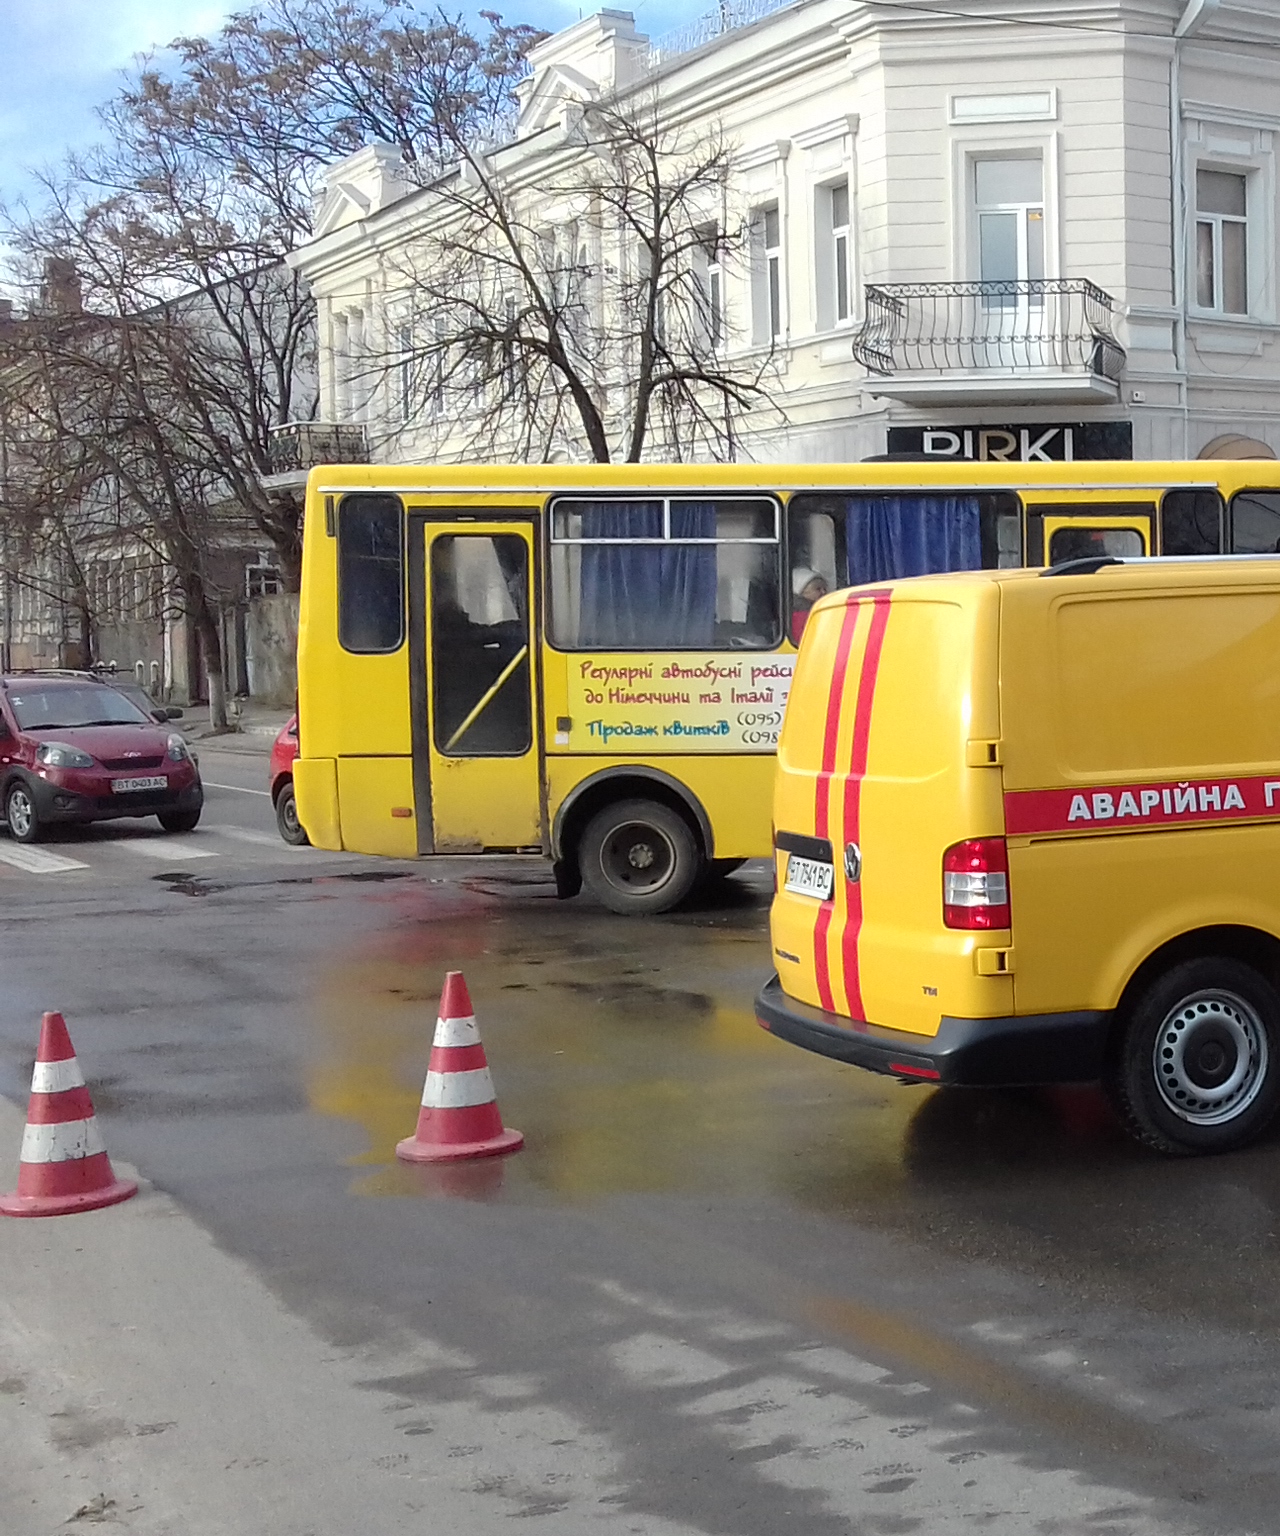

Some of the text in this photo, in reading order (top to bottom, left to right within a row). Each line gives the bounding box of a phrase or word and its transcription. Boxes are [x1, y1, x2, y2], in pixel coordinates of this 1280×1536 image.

[580, 660, 654, 687] Регулярні
[661, 660, 743, 686] автобусні
[583, 688, 604, 704] до
[608, 687, 691, 704] Німеччини
[699, 690, 722, 704] та
[731, 687, 774, 704] Італії
[586, 718, 731, 744] Продаж квитків
[737, 711, 782, 726] (095)
[1067, 781, 1246, 822] АВАРІЙНА
